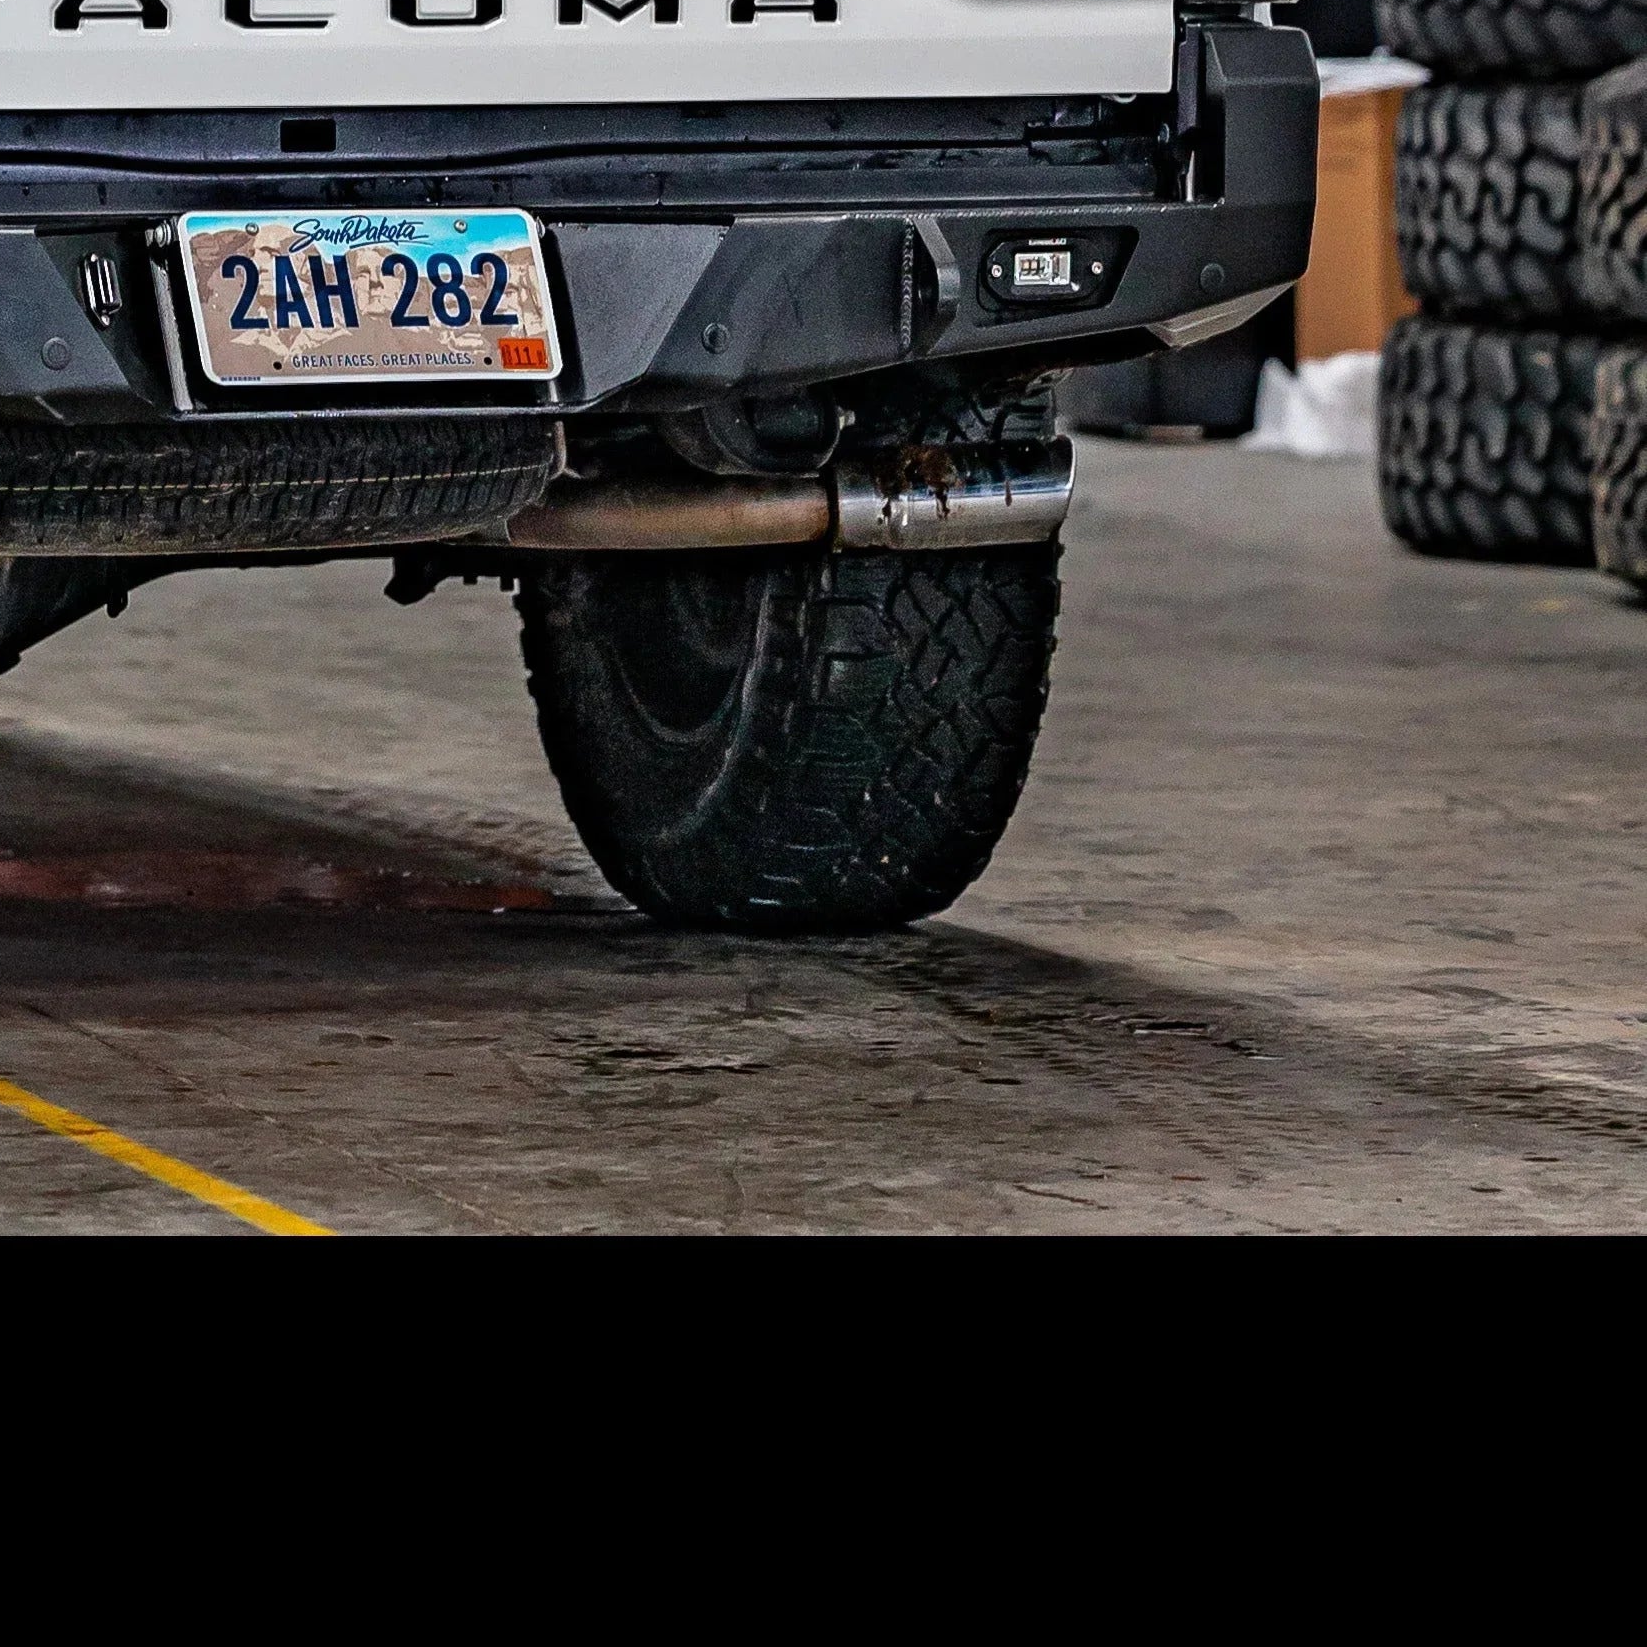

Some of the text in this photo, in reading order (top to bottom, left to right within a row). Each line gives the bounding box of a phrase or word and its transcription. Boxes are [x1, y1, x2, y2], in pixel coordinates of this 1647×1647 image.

[289, 215, 433, 253] South Dakota
[221, 252, 519, 330] 2AH 282
[292, 354, 333, 368] GREAT
[381, 353, 422, 366] GREAT
[425, 352, 475, 366] PLACES.
